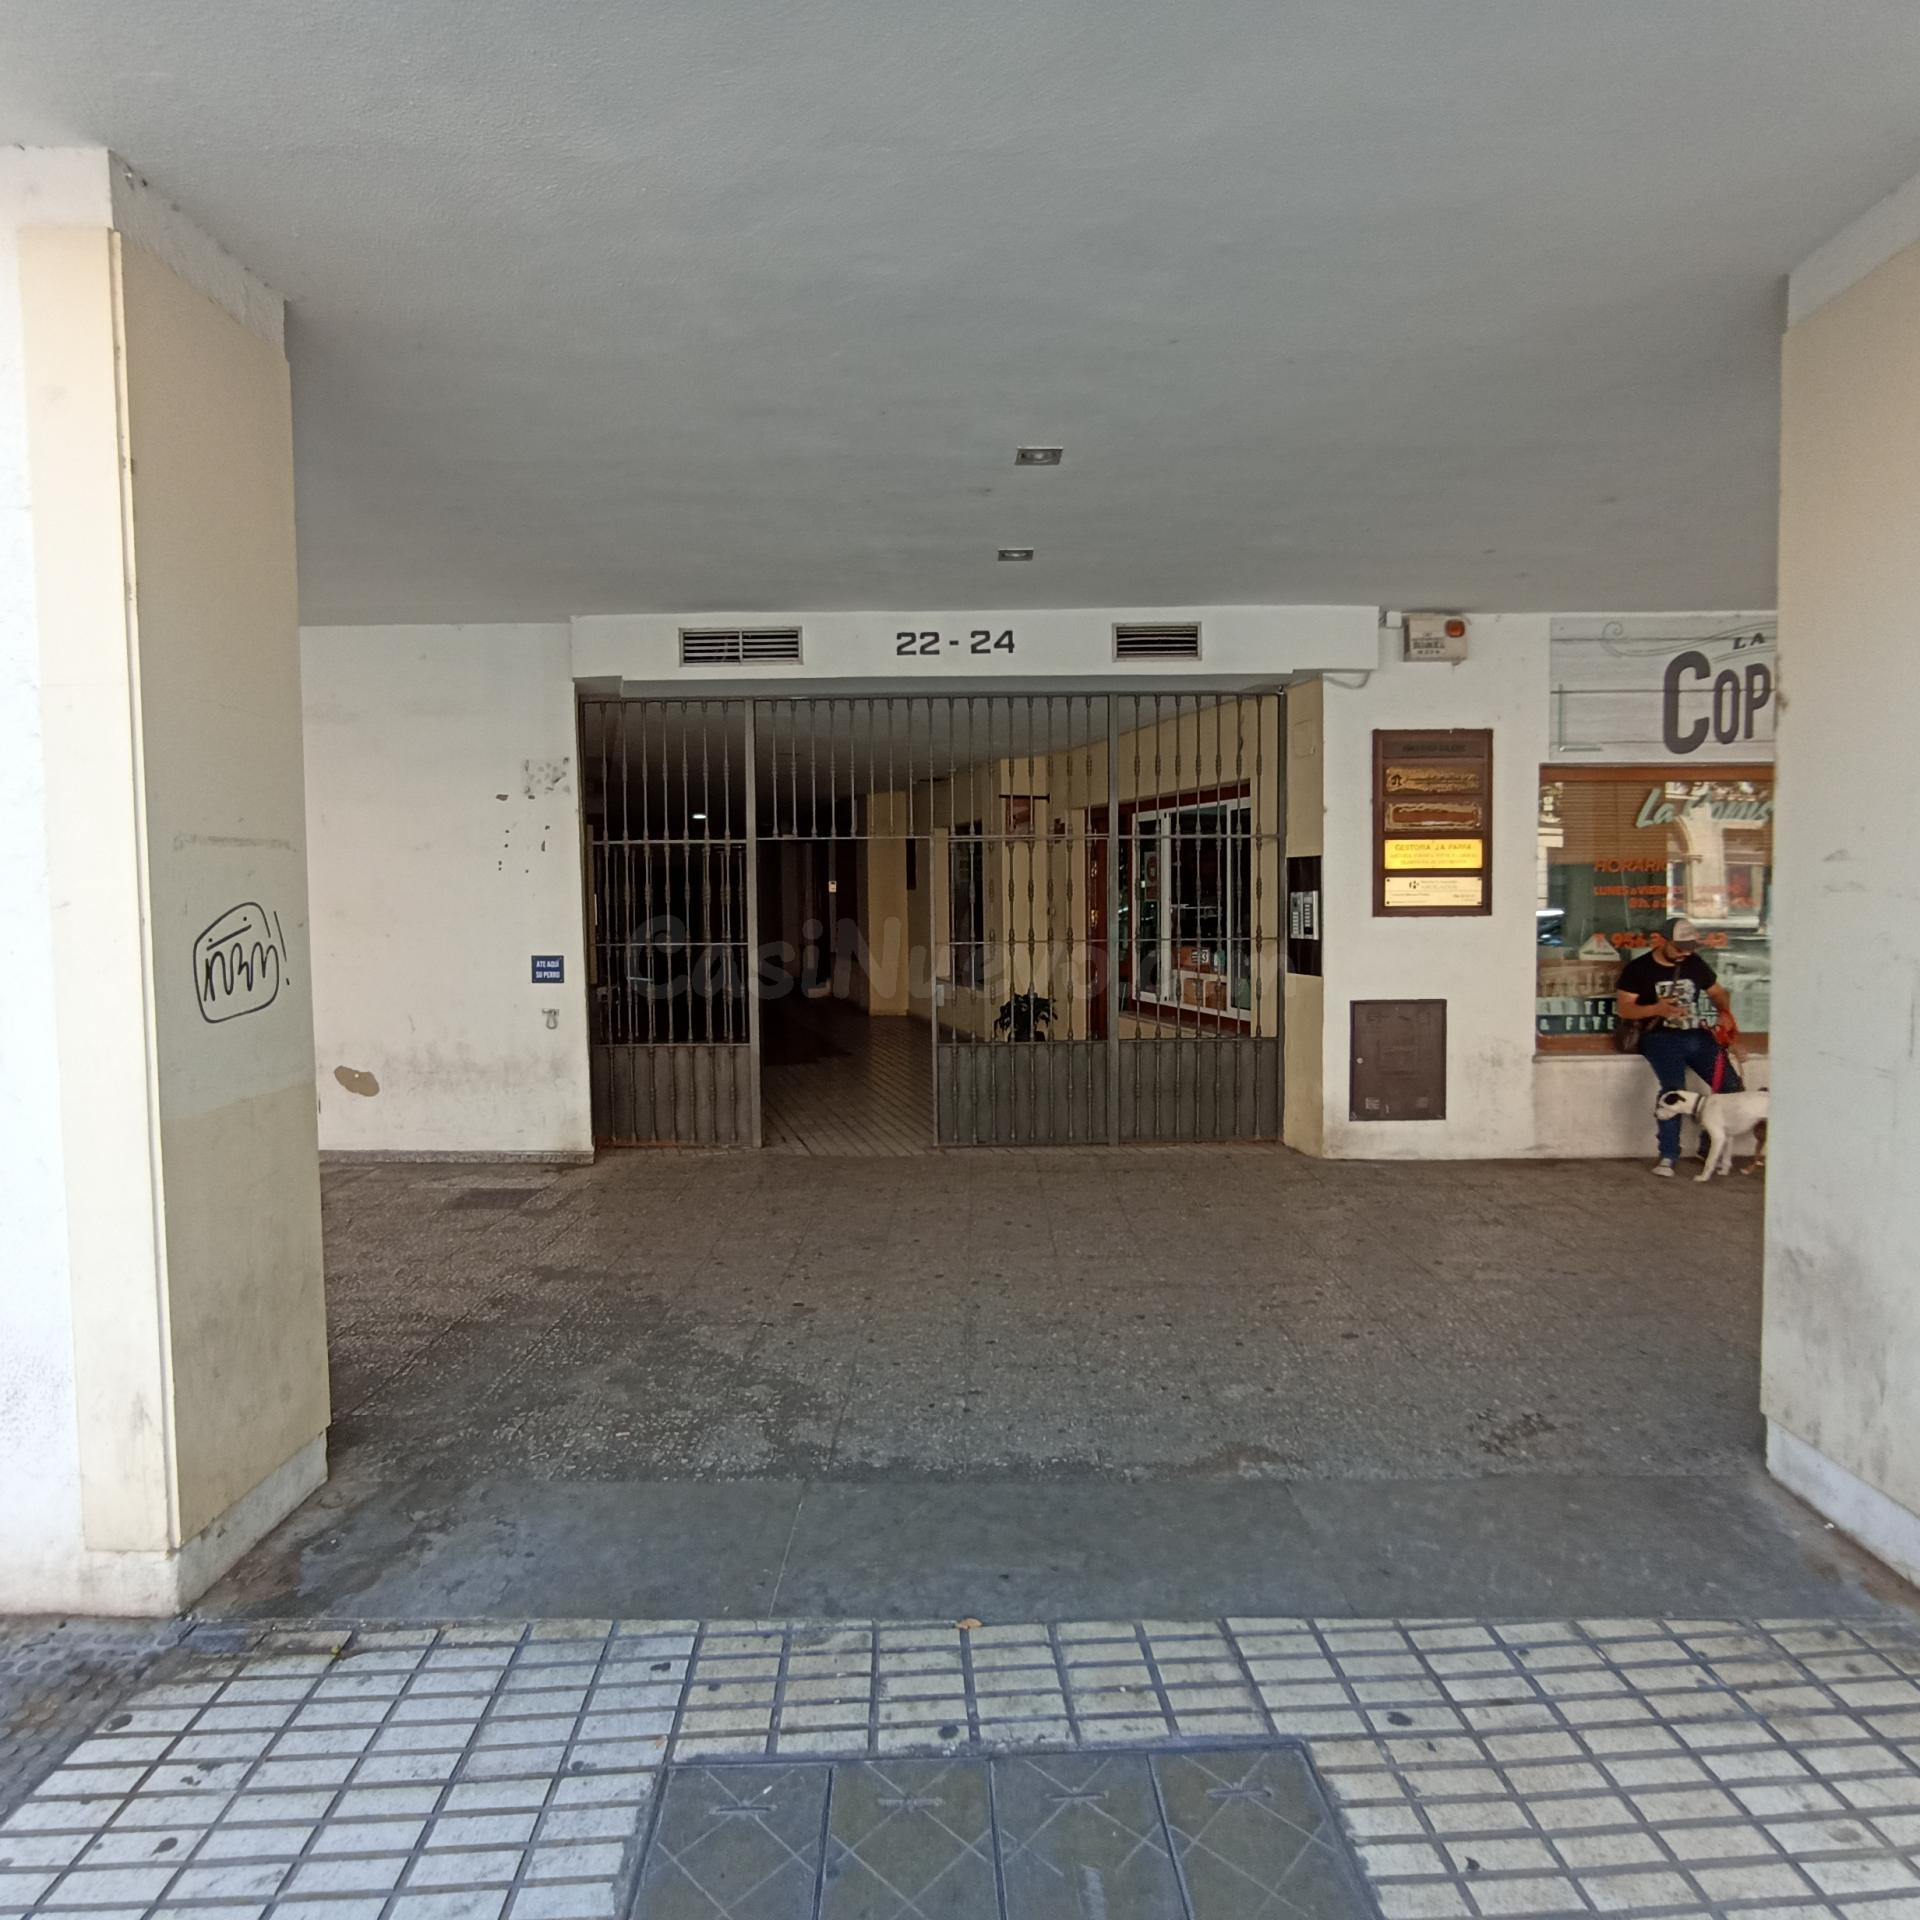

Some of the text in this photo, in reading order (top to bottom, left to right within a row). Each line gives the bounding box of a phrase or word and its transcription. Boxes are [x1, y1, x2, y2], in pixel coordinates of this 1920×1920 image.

[896, 631, 941, 656] 22
[970, 630, 1015, 654] 24
[1732, 632, 1766, 650] LA
[1635, 787, 1676, 829] La
